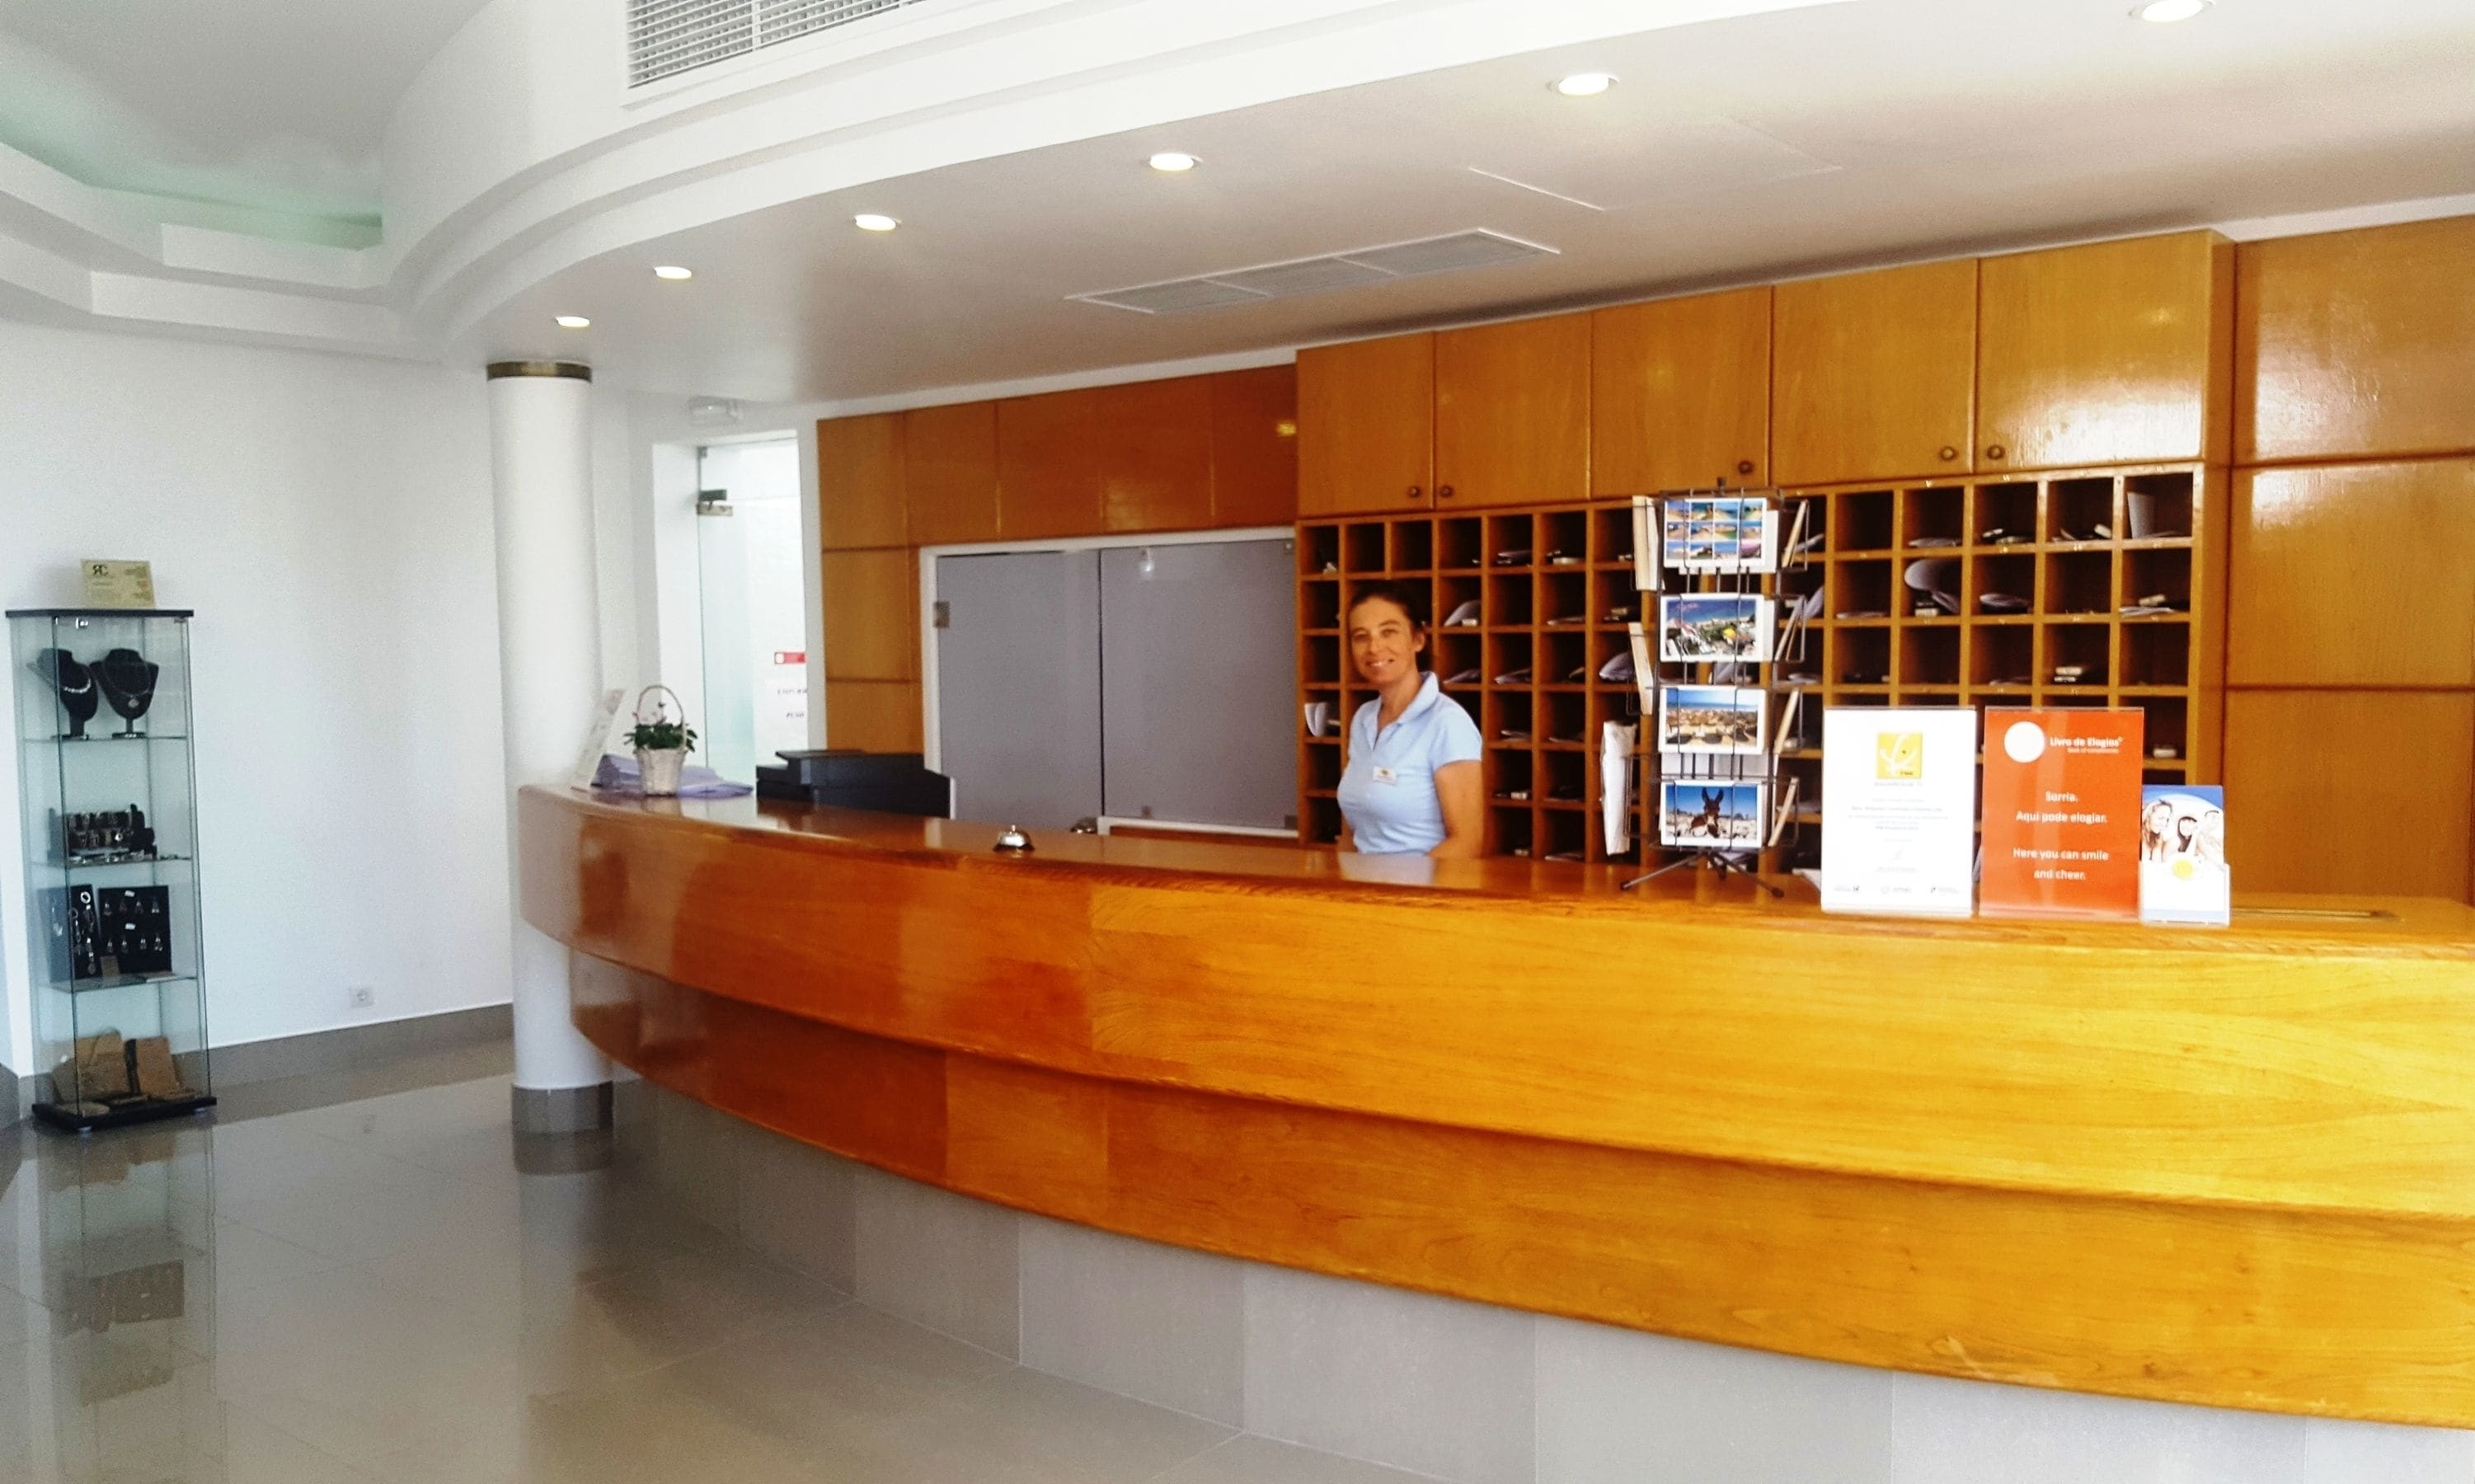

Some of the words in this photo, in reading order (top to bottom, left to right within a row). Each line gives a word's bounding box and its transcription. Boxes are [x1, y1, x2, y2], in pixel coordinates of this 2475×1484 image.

[2050, 736, 2071, 747] Livro
[2073, 736, 2086, 747] de
[2045, 791, 2078, 802] Sorria.
[2016, 811, 2040, 824] Aqui
[2042, 812, 2068, 824] pode
[2013, 848, 2039, 859] Here
[2040, 849, 2059, 861] you
[2060, 850, 2079, 861] can
[2082, 850, 2109, 861] smile
[2034, 869, 2054, 881] and
